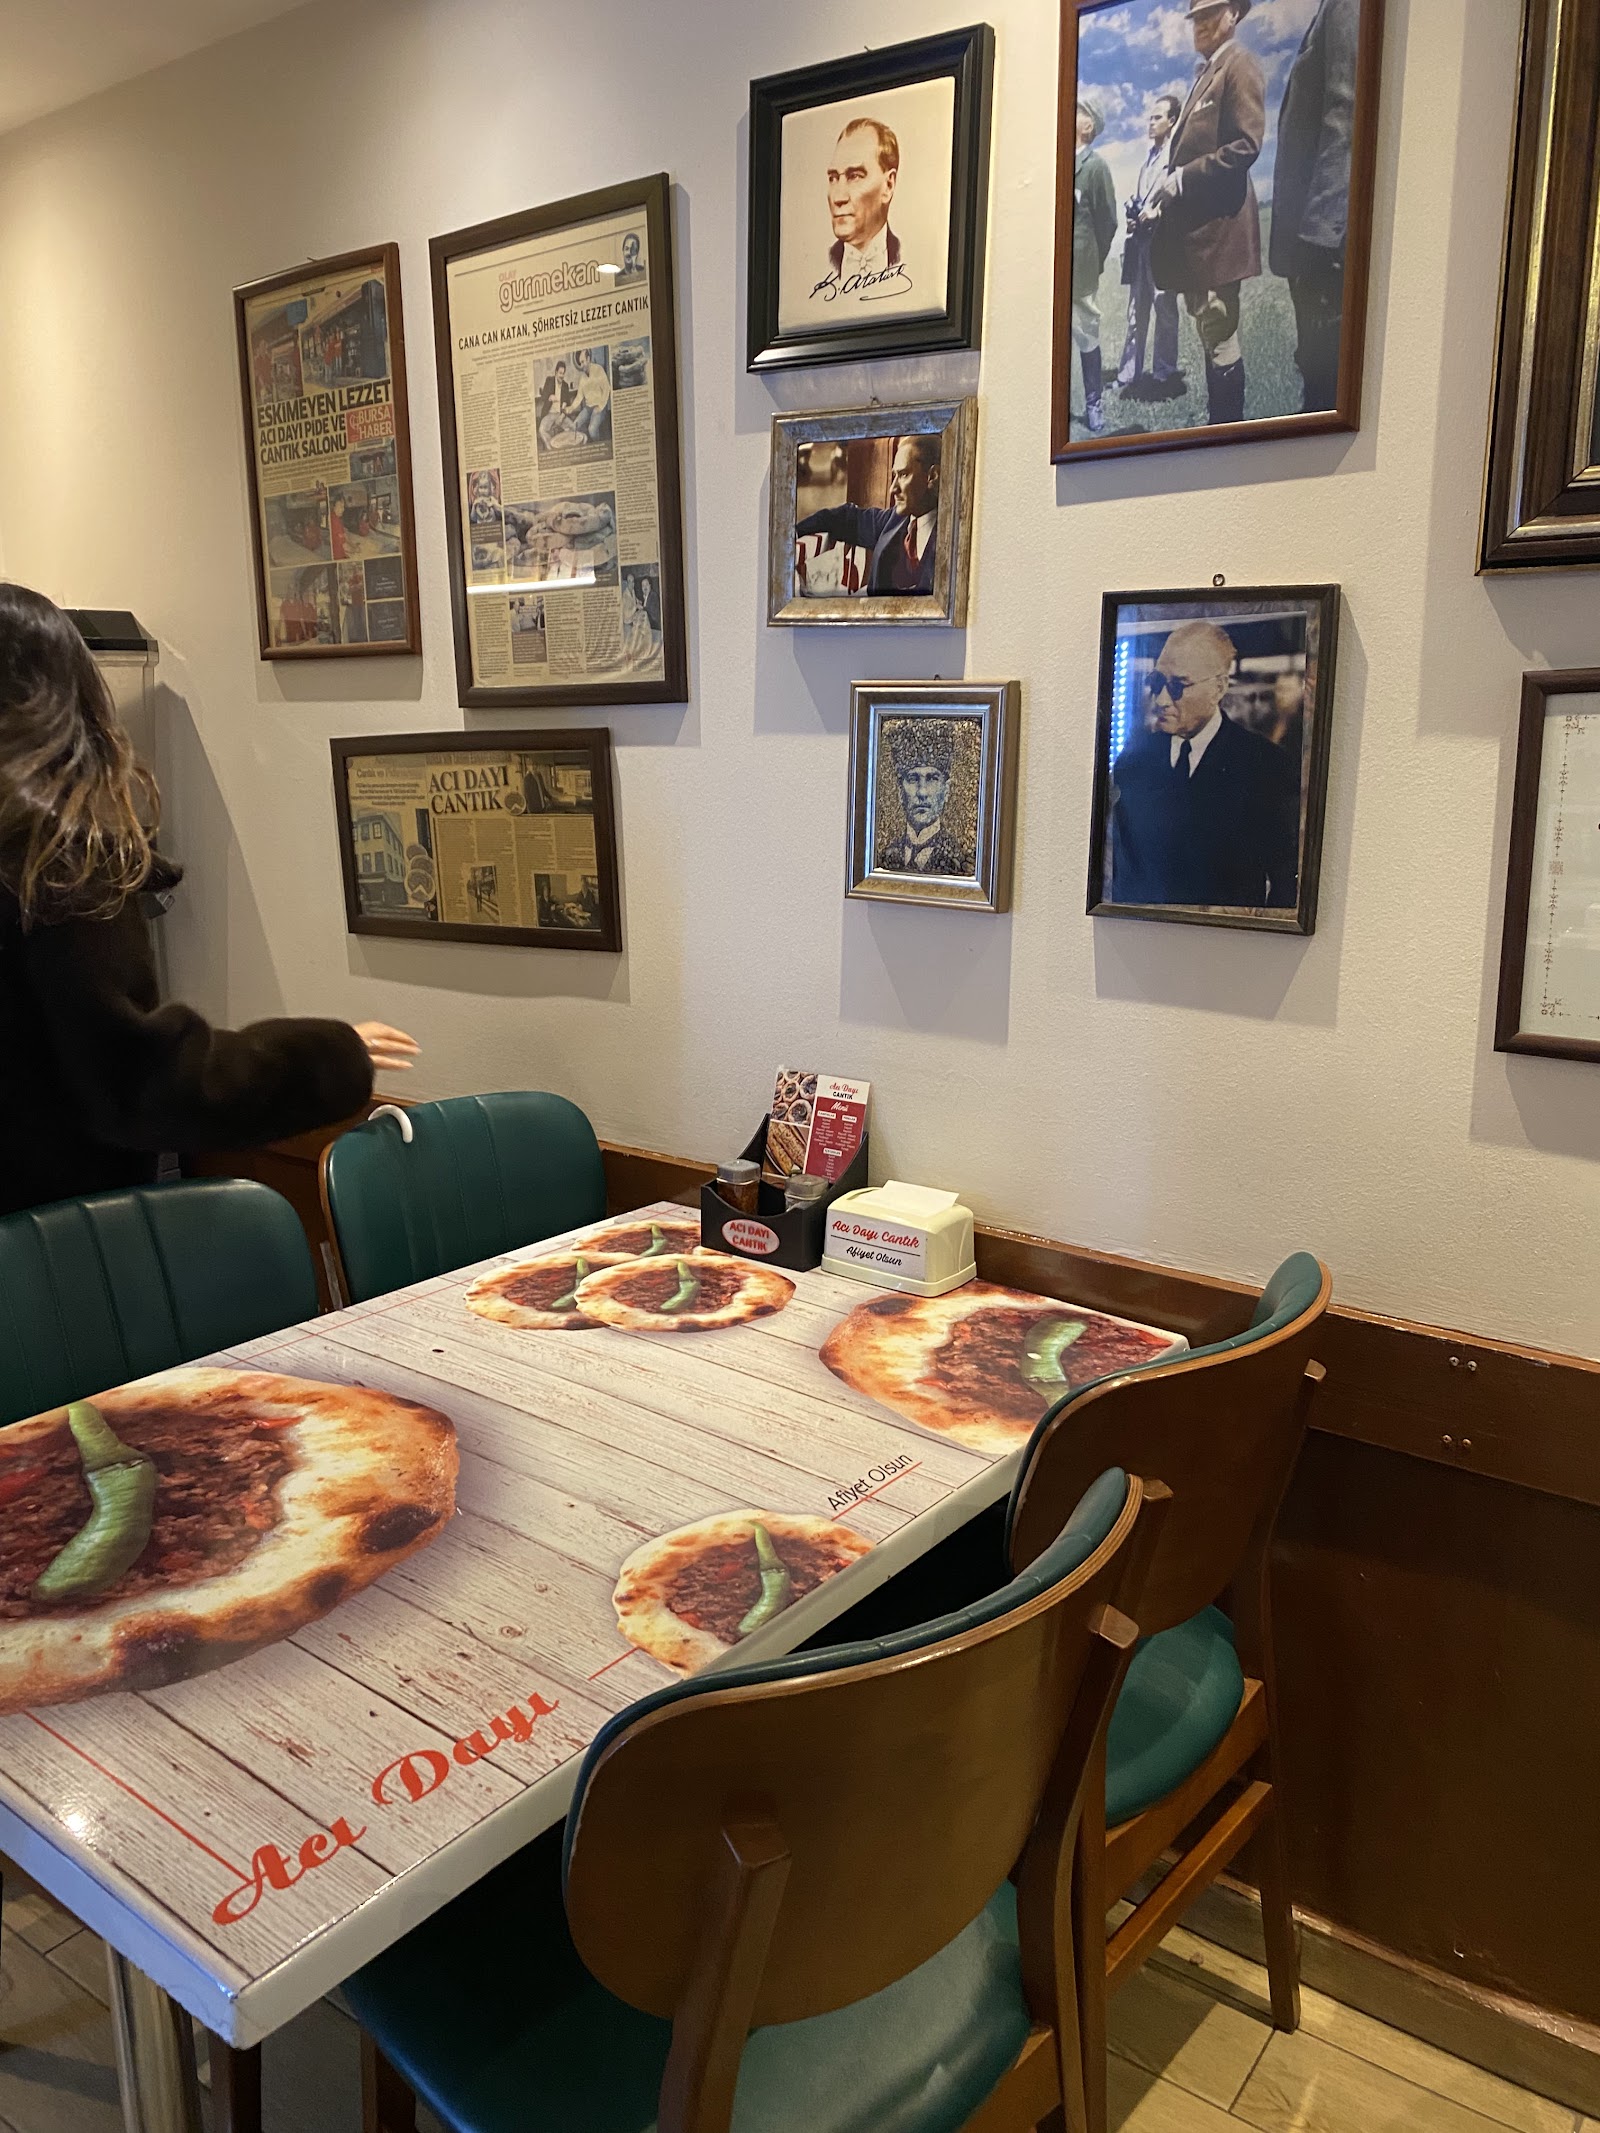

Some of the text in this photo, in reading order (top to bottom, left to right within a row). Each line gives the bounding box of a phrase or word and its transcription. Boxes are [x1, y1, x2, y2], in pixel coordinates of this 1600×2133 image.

[499, 260, 601, 313] gurmekan
[458, 295, 649, 350] CANA CAN KATAN, ŞÖHRETSİZ LEZZET CANTIK
[338, 379, 391, 411] LEZZET
[359, 405, 391, 425] BURSA
[260, 427, 276, 447] ACI
[278, 422, 302, 443] DAYI
[331, 413, 346, 432] VE
[359, 420, 393, 440] HABER
[260, 432, 347, 465] CANTIK SALONU
[429, 771, 460, 793] ACI
[463, 765, 509, 789] DAYI
[431, 790, 503, 814] CANTIK
[729, 1221, 770, 1239] ACI DAYI
[732, 1236, 767, 1251] CANTIK
[832, 1220, 920, 1248] Acı Dayı Cantık
[846, 1246, 902, 1266] Afiyet Olsun
[827, 1454, 913, 1511] Afiyet Olsun
[212, 1690, 560, 1925] Acı Dayı
